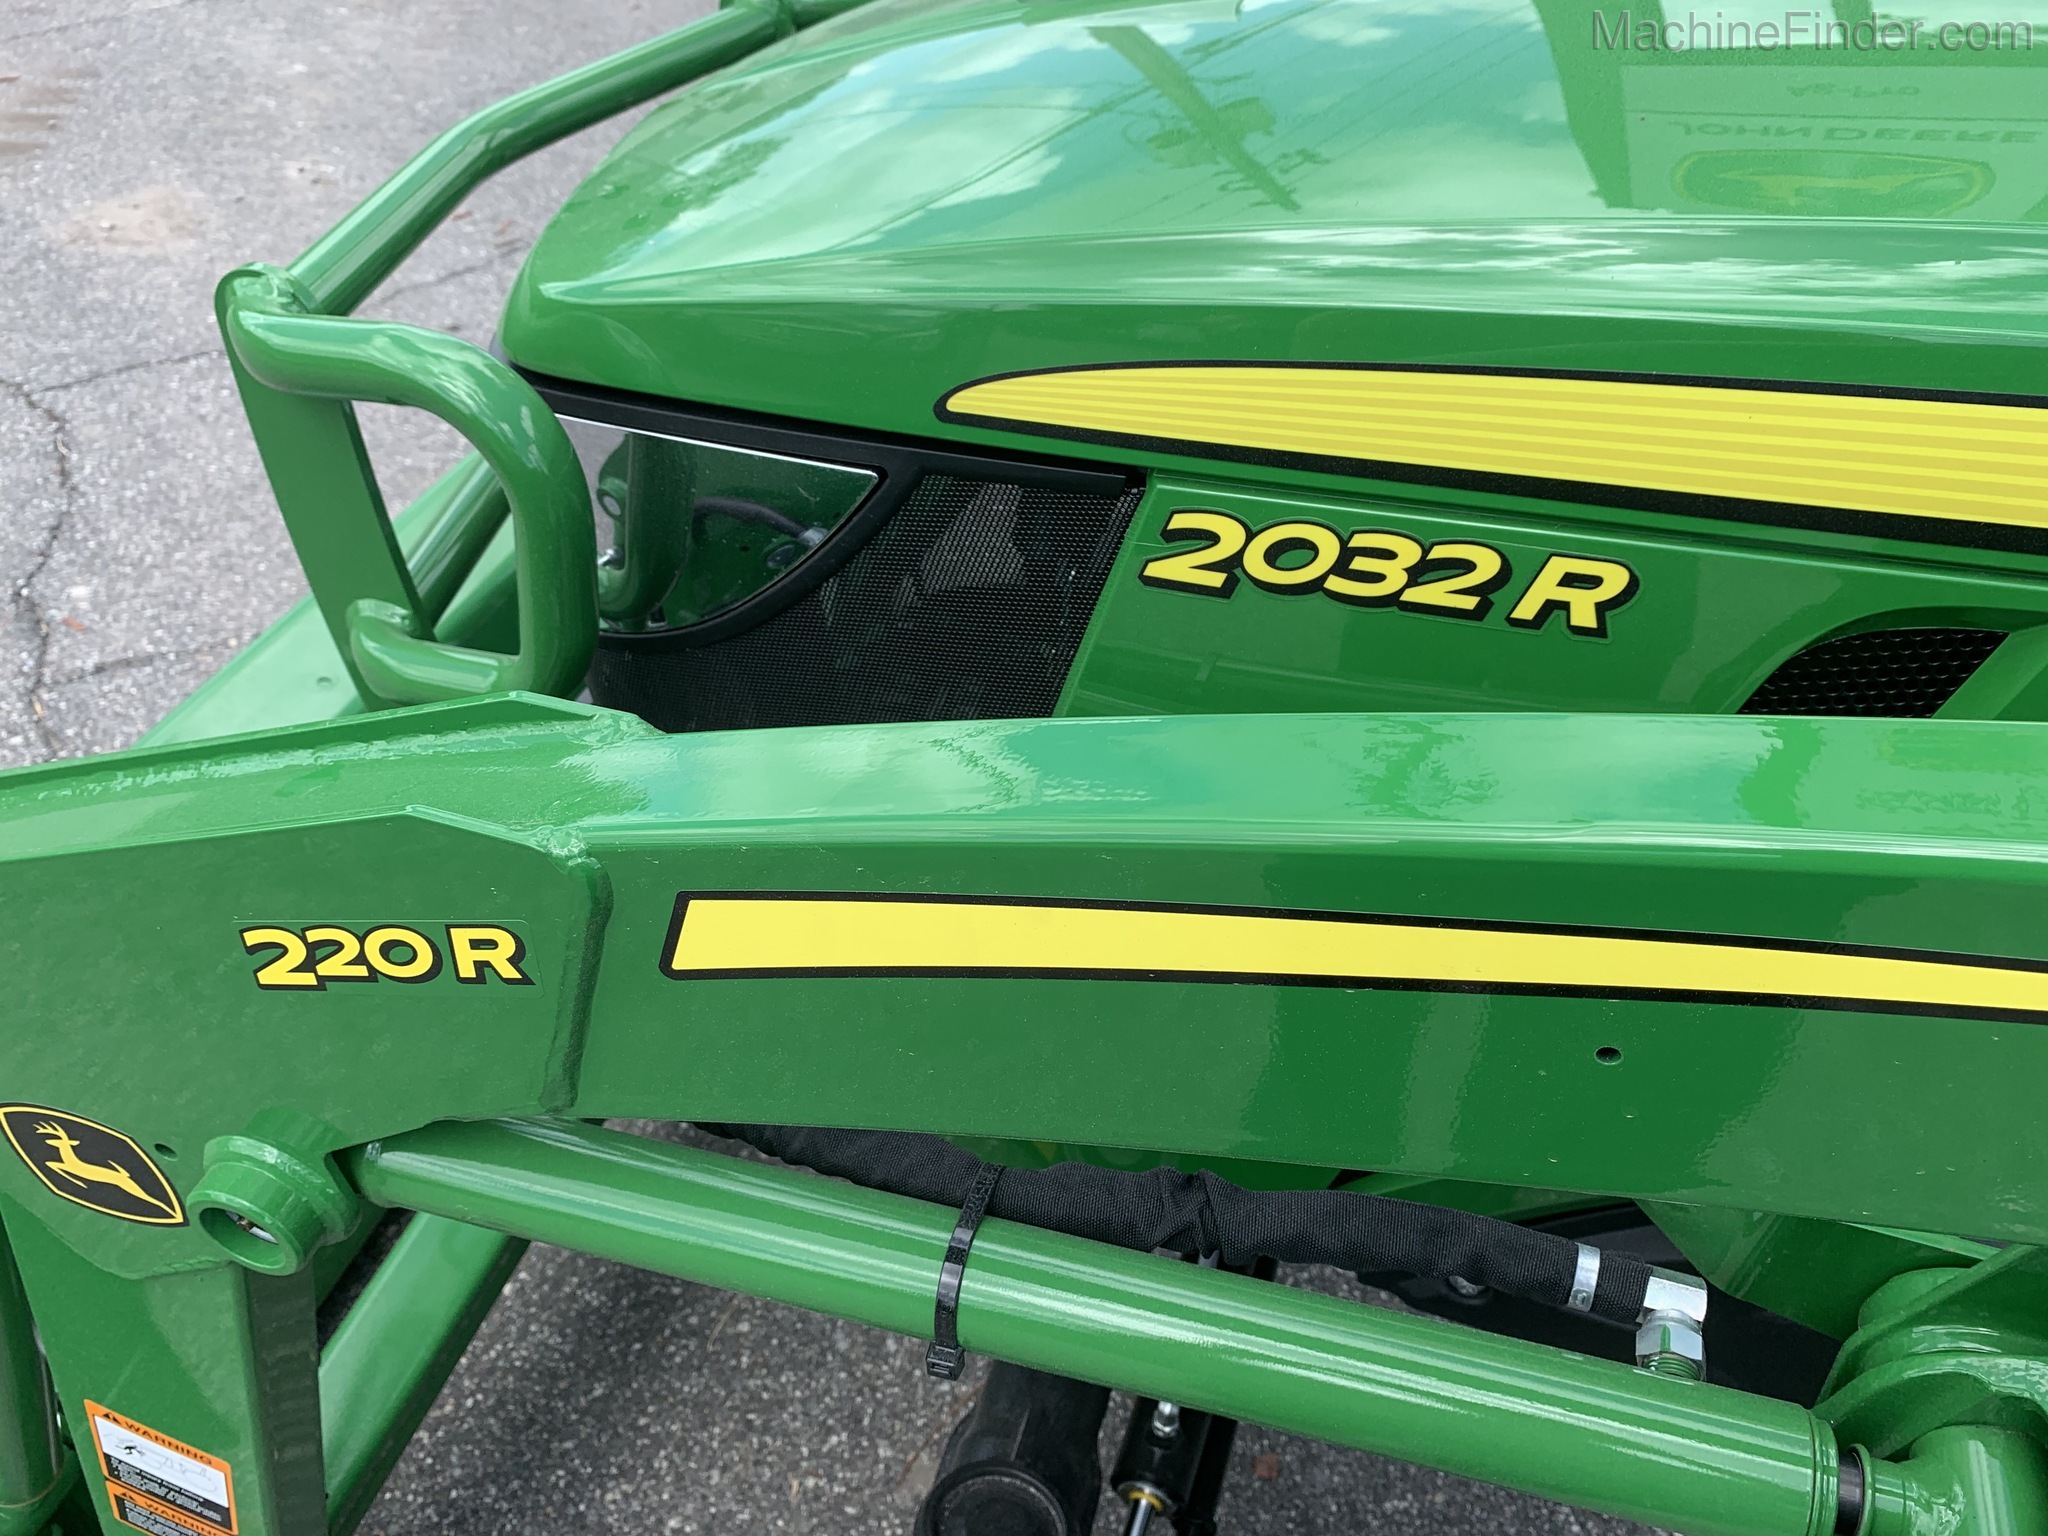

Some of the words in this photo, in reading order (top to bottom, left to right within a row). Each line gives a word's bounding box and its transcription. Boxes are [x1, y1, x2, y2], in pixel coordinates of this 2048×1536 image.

[1139, 509, 1509, 618] 2032
[1505, 554, 1637, 636] R
[239, 924, 442, 990] 220
[446, 925, 534, 984] R
[125, 1421, 213, 1466] WARNING
